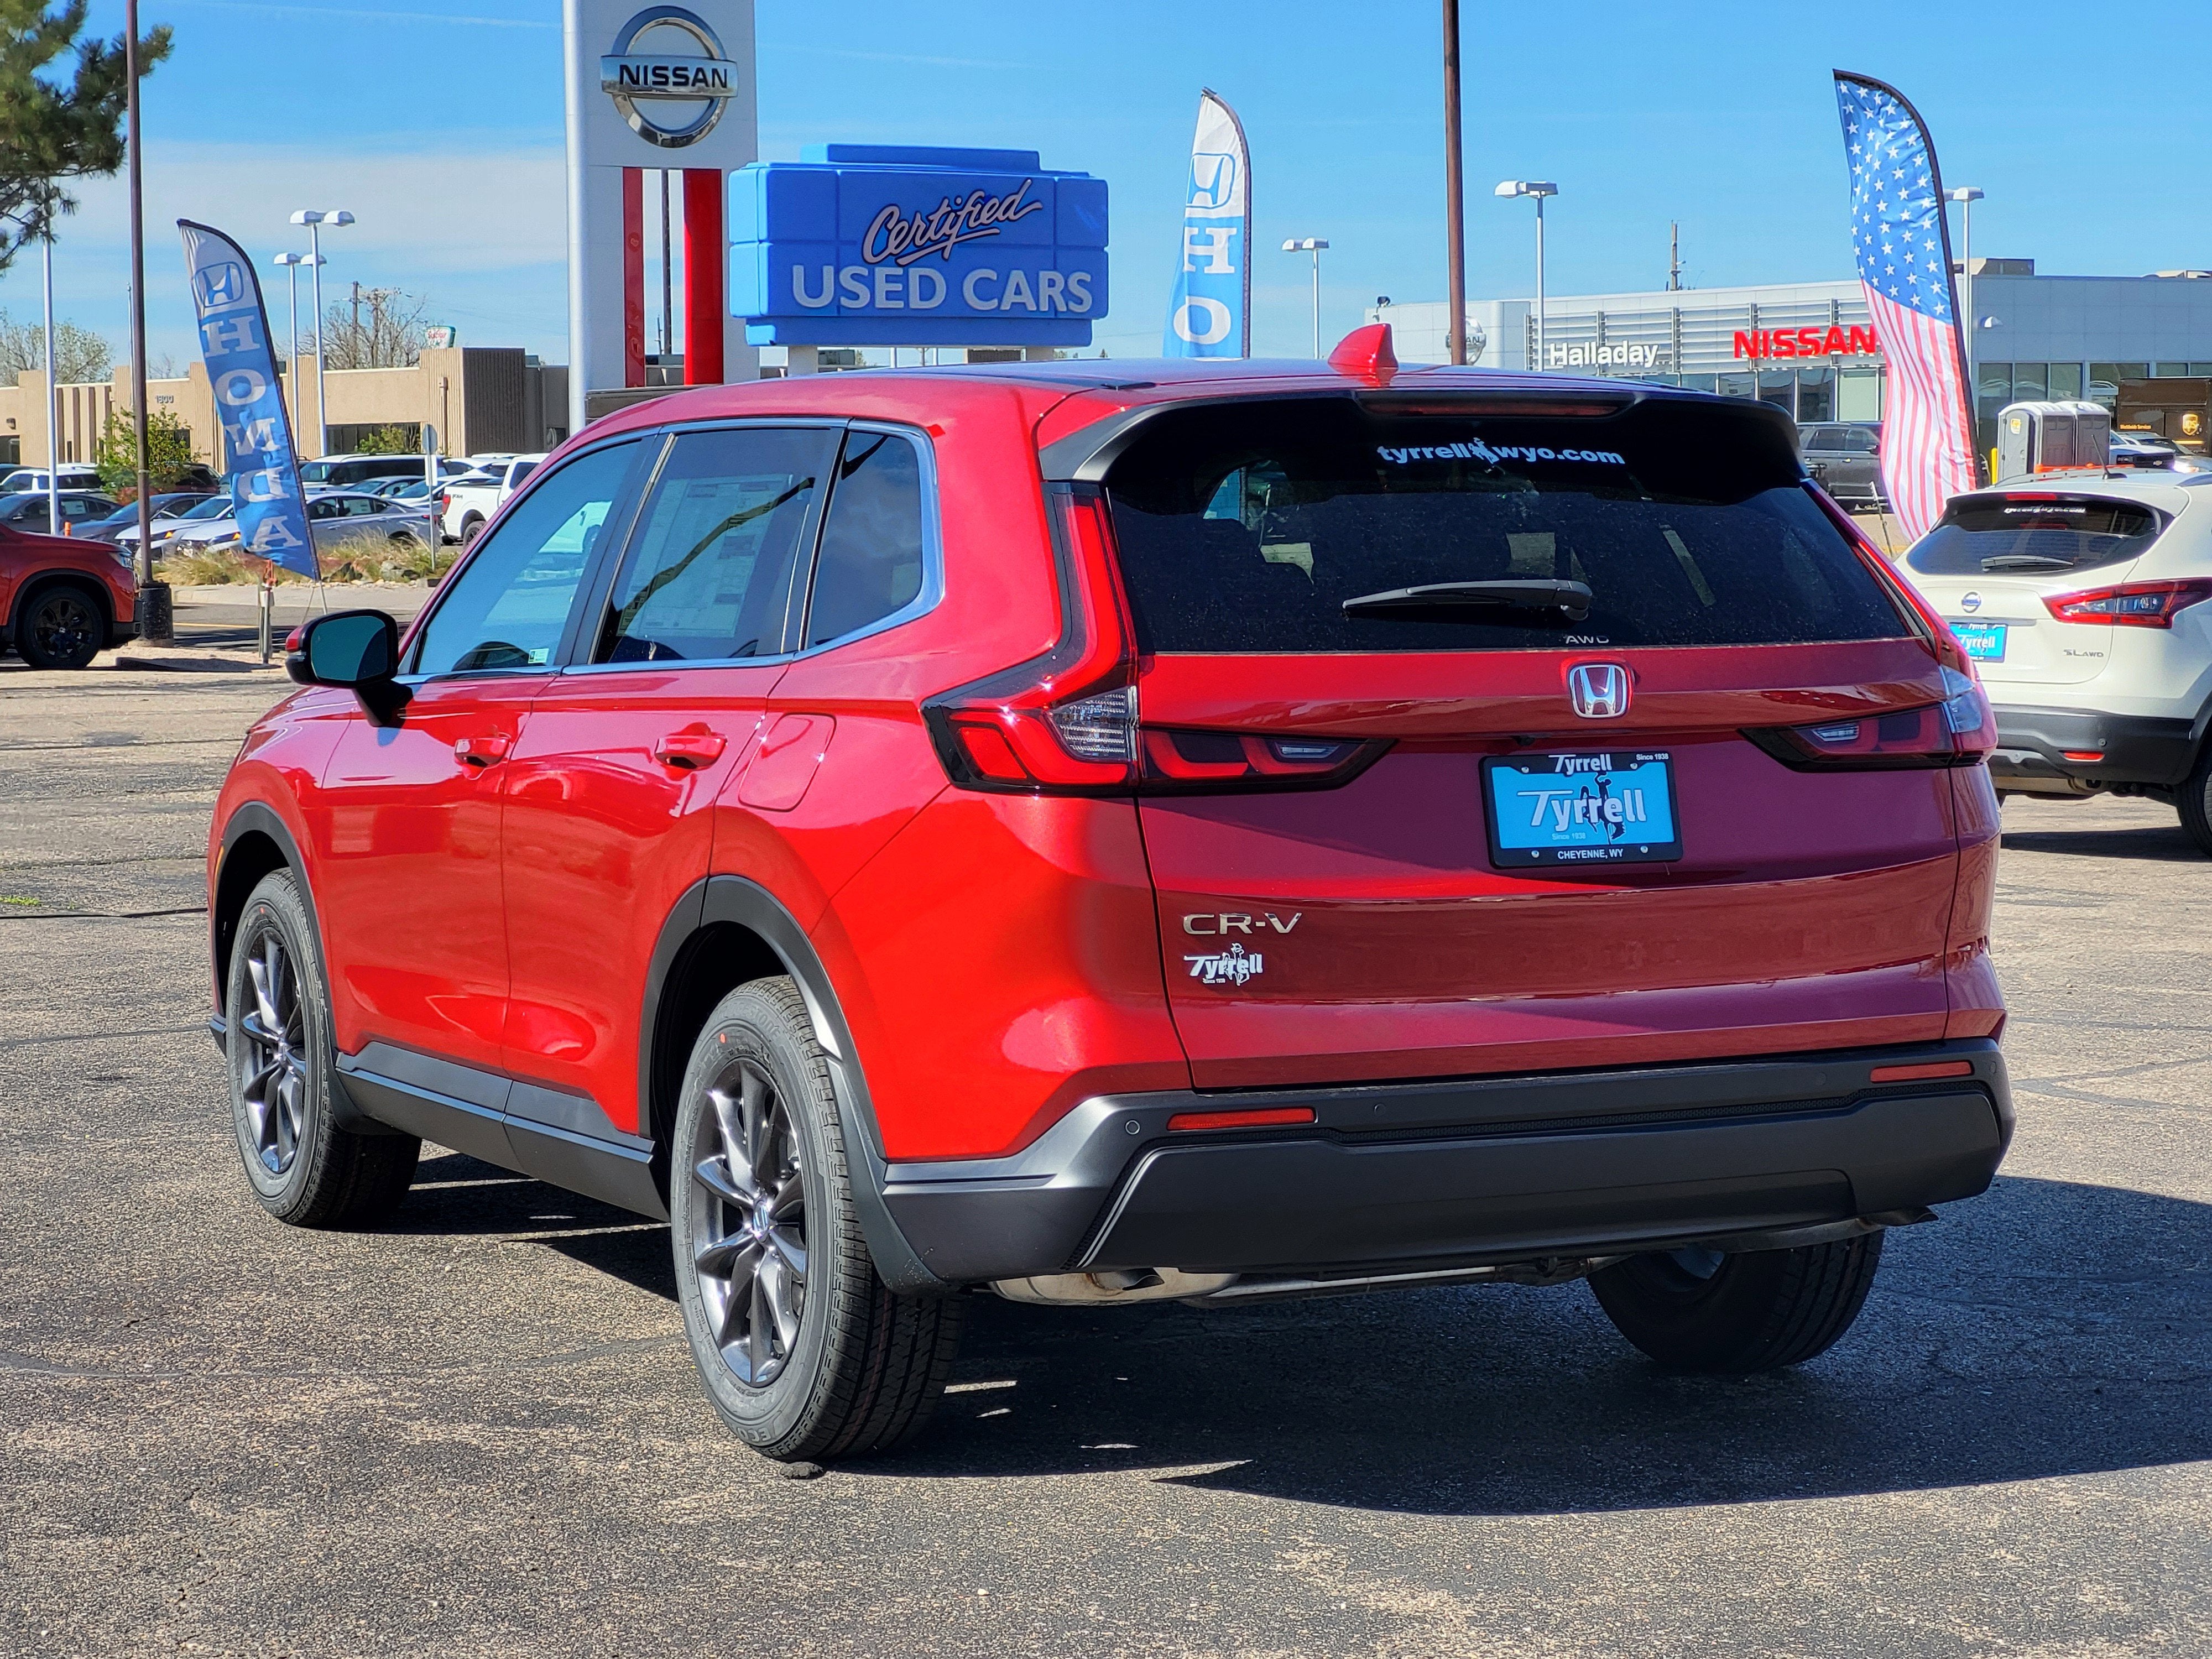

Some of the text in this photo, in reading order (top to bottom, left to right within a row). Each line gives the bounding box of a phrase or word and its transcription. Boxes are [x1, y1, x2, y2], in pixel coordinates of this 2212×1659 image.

[618, 64, 728, 89] NISSAN
[862, 178, 1044, 266] Certified
[791, 264, 1093, 314] USED CARS
[1549, 340, 1658, 368] Halladay
[1733, 324, 1877, 359] NISSAN
[1565, 635, 1609, 644] AWD
[1956, 634, 1995, 650] Tyrrell
[1548, 753, 1613, 775] Tyrrell
[1517, 789, 1647, 832] Tyrrell
[1552, 832, 1570, 841] Since
[1557, 848, 1624, 860] CHEYENNE, WY
[1183, 912, 1302, 935] CR-V
[1183, 953, 1263, 979] Tyrrell
